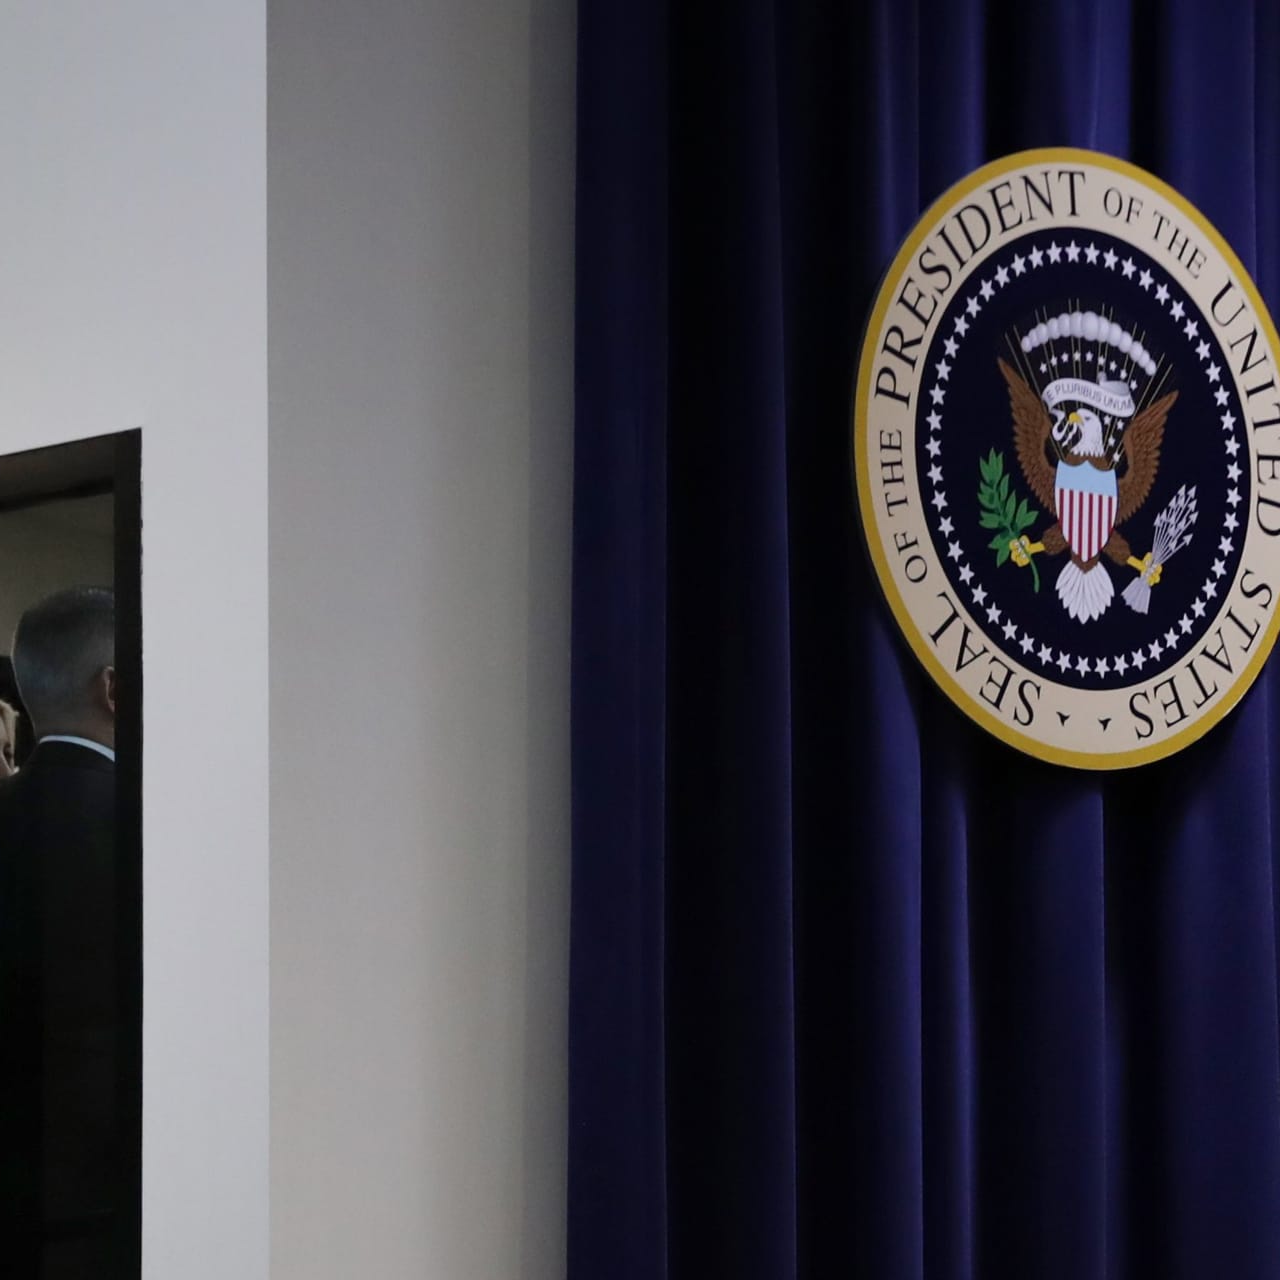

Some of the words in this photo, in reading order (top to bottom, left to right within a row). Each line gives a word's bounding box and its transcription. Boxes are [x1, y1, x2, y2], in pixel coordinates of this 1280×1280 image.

[1103, 186, 1144, 224] OF
[1152, 210, 1208, 280] THE
[874, 169, 1086, 410] PRESIDENT
[1046, 389, 1055, 401] E
[1054, 382, 1103, 402] PLURIBUS
[1103, 393, 1135, 411] UNUM
[879, 429, 910, 517] THE
[893, 530, 928, 583] OF
[929, 591, 1041, 726] SEAL
[1128, 568, 1273, 740] STATES
